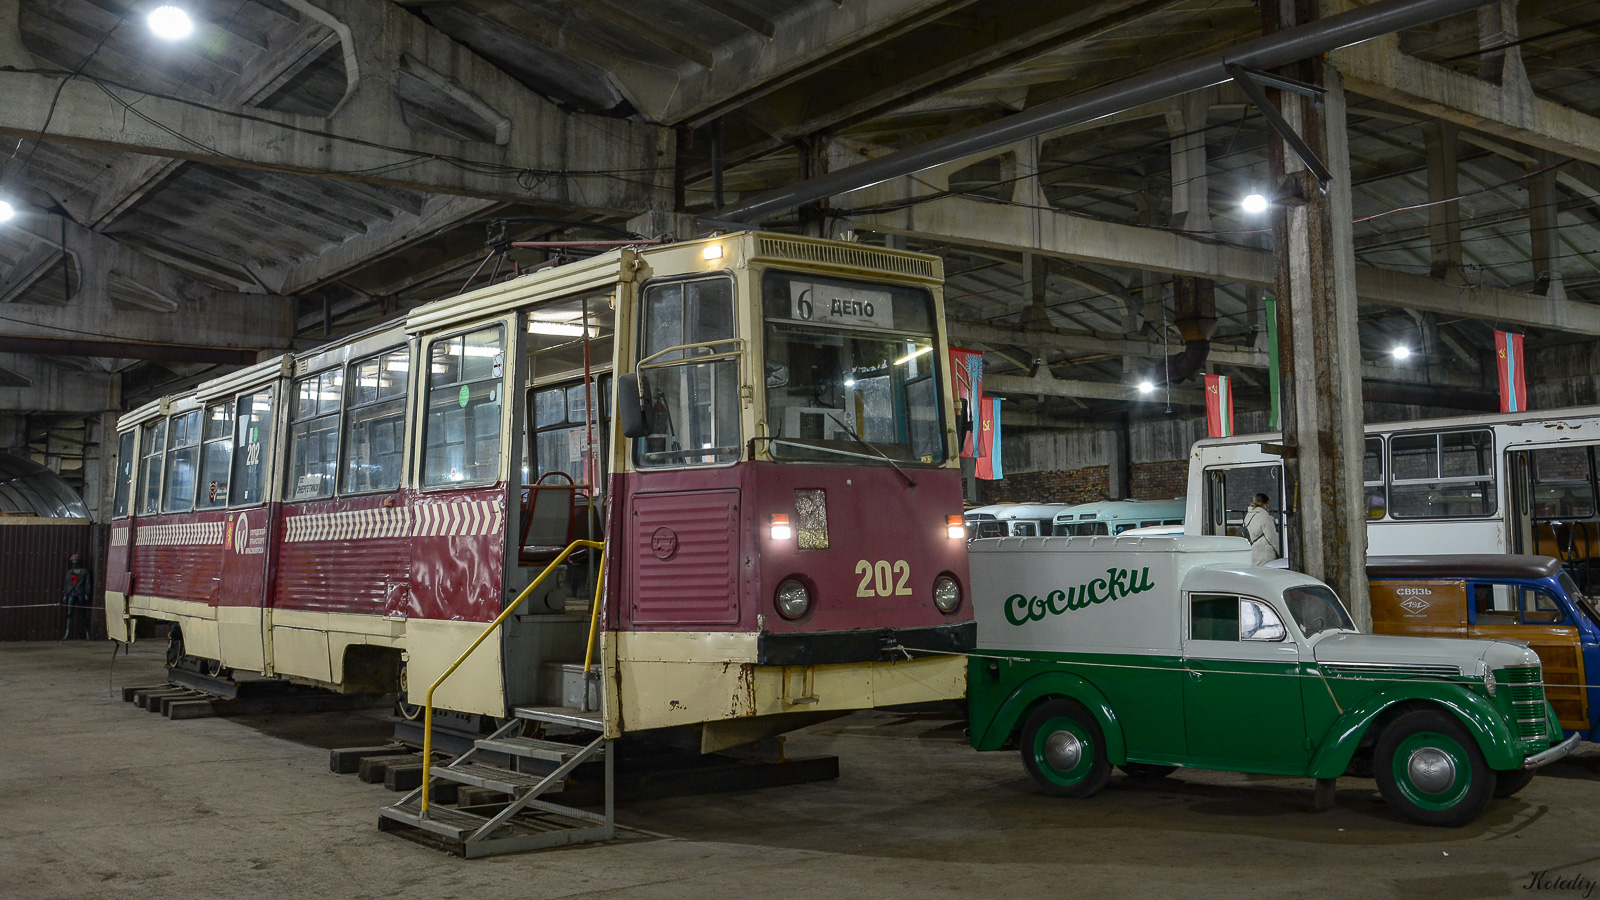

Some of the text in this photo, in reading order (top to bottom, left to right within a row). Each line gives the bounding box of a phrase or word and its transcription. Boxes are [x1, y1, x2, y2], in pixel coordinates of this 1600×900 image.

[798, 289, 875, 321] 6 ДЕПО
[246, 442, 260, 466] 202
[855, 559, 913, 598] 202
[1396, 588, 1432, 596] СВЯЗЬ
